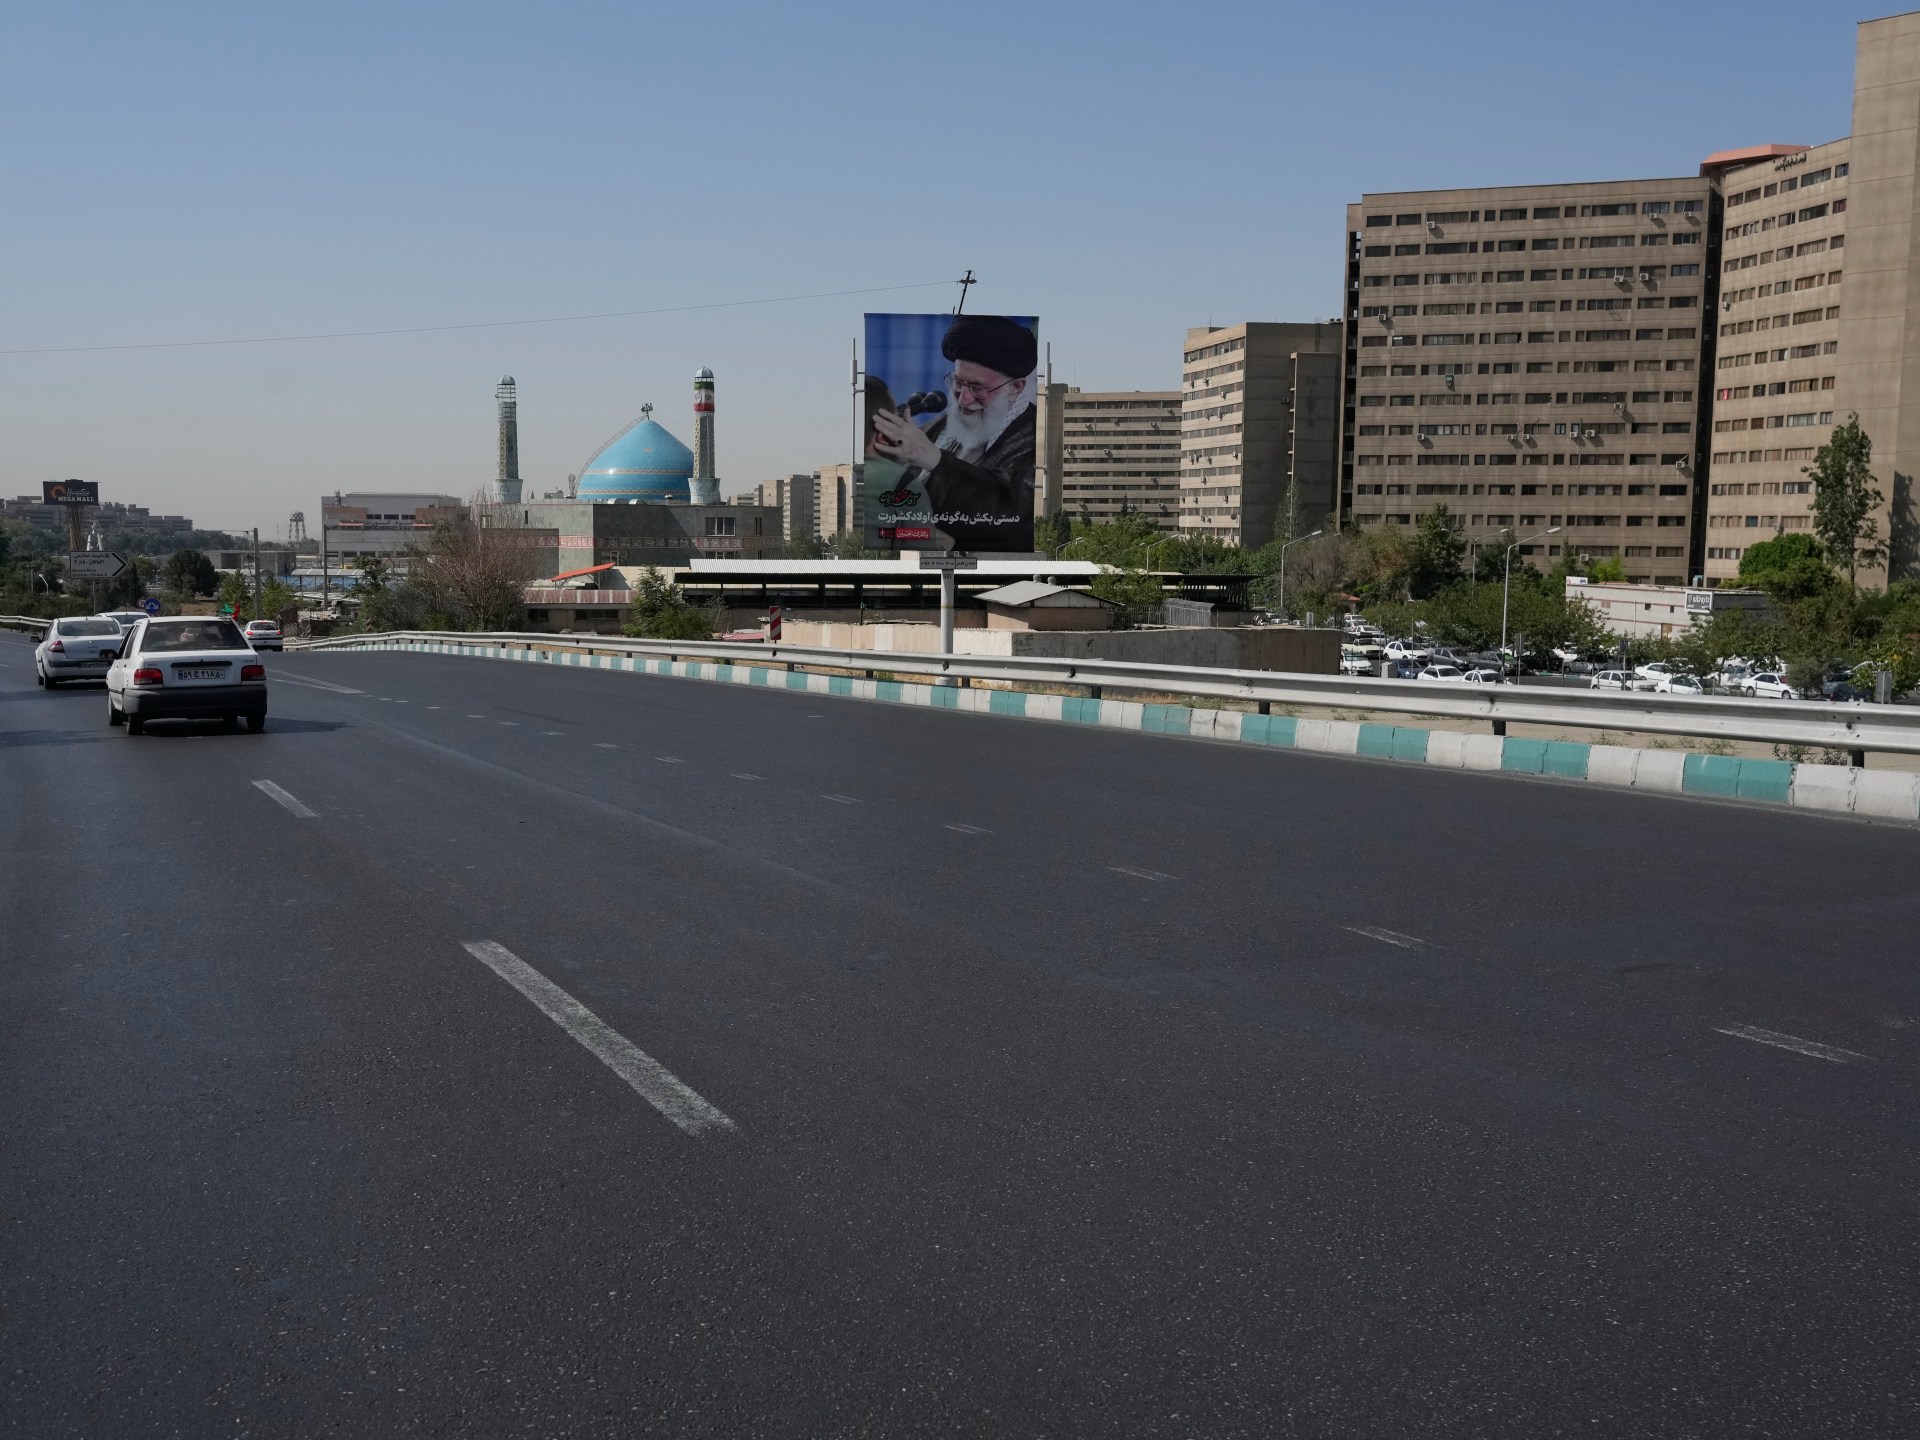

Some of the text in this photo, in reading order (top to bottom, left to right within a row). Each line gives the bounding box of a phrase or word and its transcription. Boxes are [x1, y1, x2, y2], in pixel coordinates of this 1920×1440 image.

[878, 510, 912, 524] کشورت
[912, 511, 930, 524] اولاد
[960, 513, 969, 525] به
[969, 512, 993, 525] بکش
[994, 514, 1020, 526] دستی
